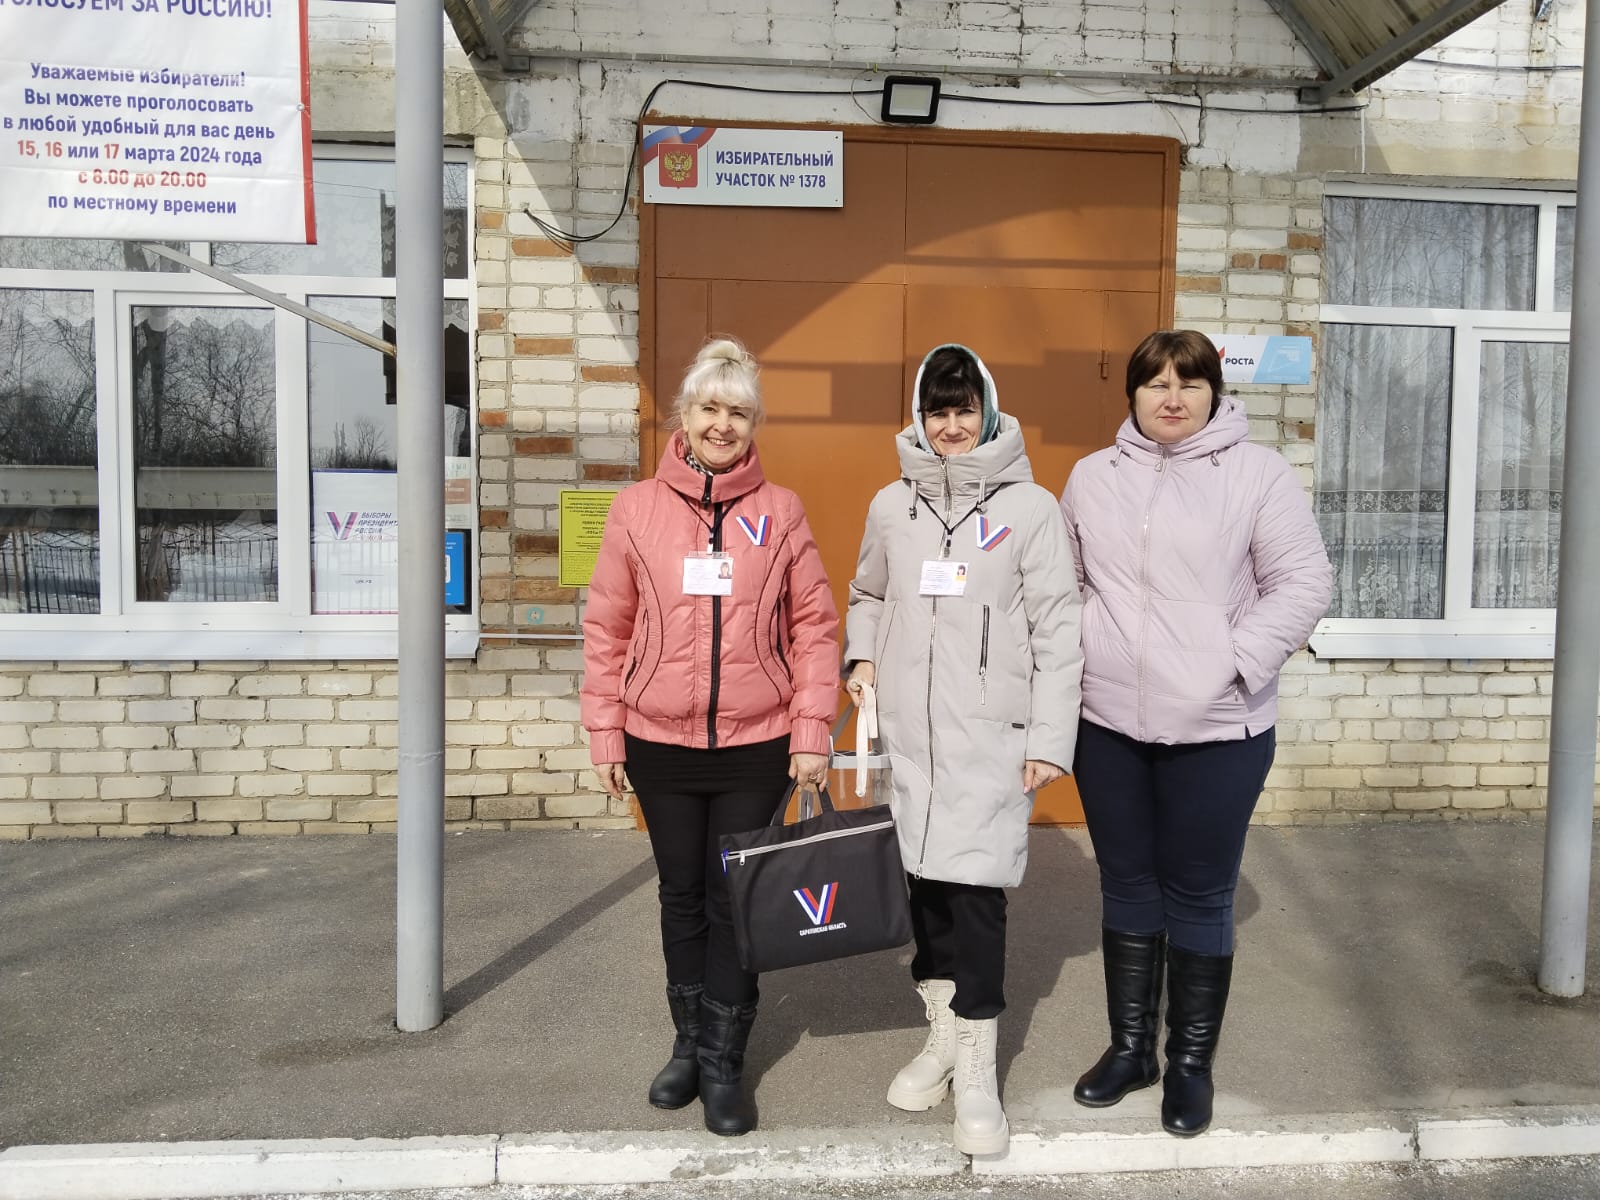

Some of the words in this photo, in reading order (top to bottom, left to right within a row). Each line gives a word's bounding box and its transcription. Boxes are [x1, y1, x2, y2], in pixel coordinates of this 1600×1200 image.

[131, 0, 160, 12] ЗА
[166, 0, 272, 18] РОССИЮ!
[30, 62, 135, 82] Уважаемые
[139, 68, 246, 88] избиратели!
[24, 88, 51, 105] Вы
[56, 93, 122, 107] можете
[127, 95, 254, 113] проголосовать
[3, 117, 14, 129] в
[18, 114, 77, 132] любой
[82, 117, 160, 137] удобный
[164, 123, 196, 139] для
[201, 125, 230, 138] вас
[234, 125, 275, 140] день
[17, 139, 40, 159] 15,
[45, 141, 63, 158] 16
[67, 145, 99, 159] или
[104, 143, 120, 160] 17
[124, 147, 175, 164] марта
[180, 146, 220, 163] 2024
[224, 151, 262, 166] года
[715, 150, 834, 167] ИЗБИРАТЕЛЬНЫЙ
[78, 171, 88, 184] с
[93, 168, 129, 185] 8.00
[133, 173, 156, 188] до
[160, 171, 207, 188] 20.00
[715, 172, 776, 187] УЧАСТОК
[779, 174, 795, 187] №
[799, 174, 826, 188] 1378
[48, 195, 68, 209] по
[73, 196, 159, 215] местному
[163, 199, 237, 216] времени
[1225, 357, 1255, 366] РОСТА
